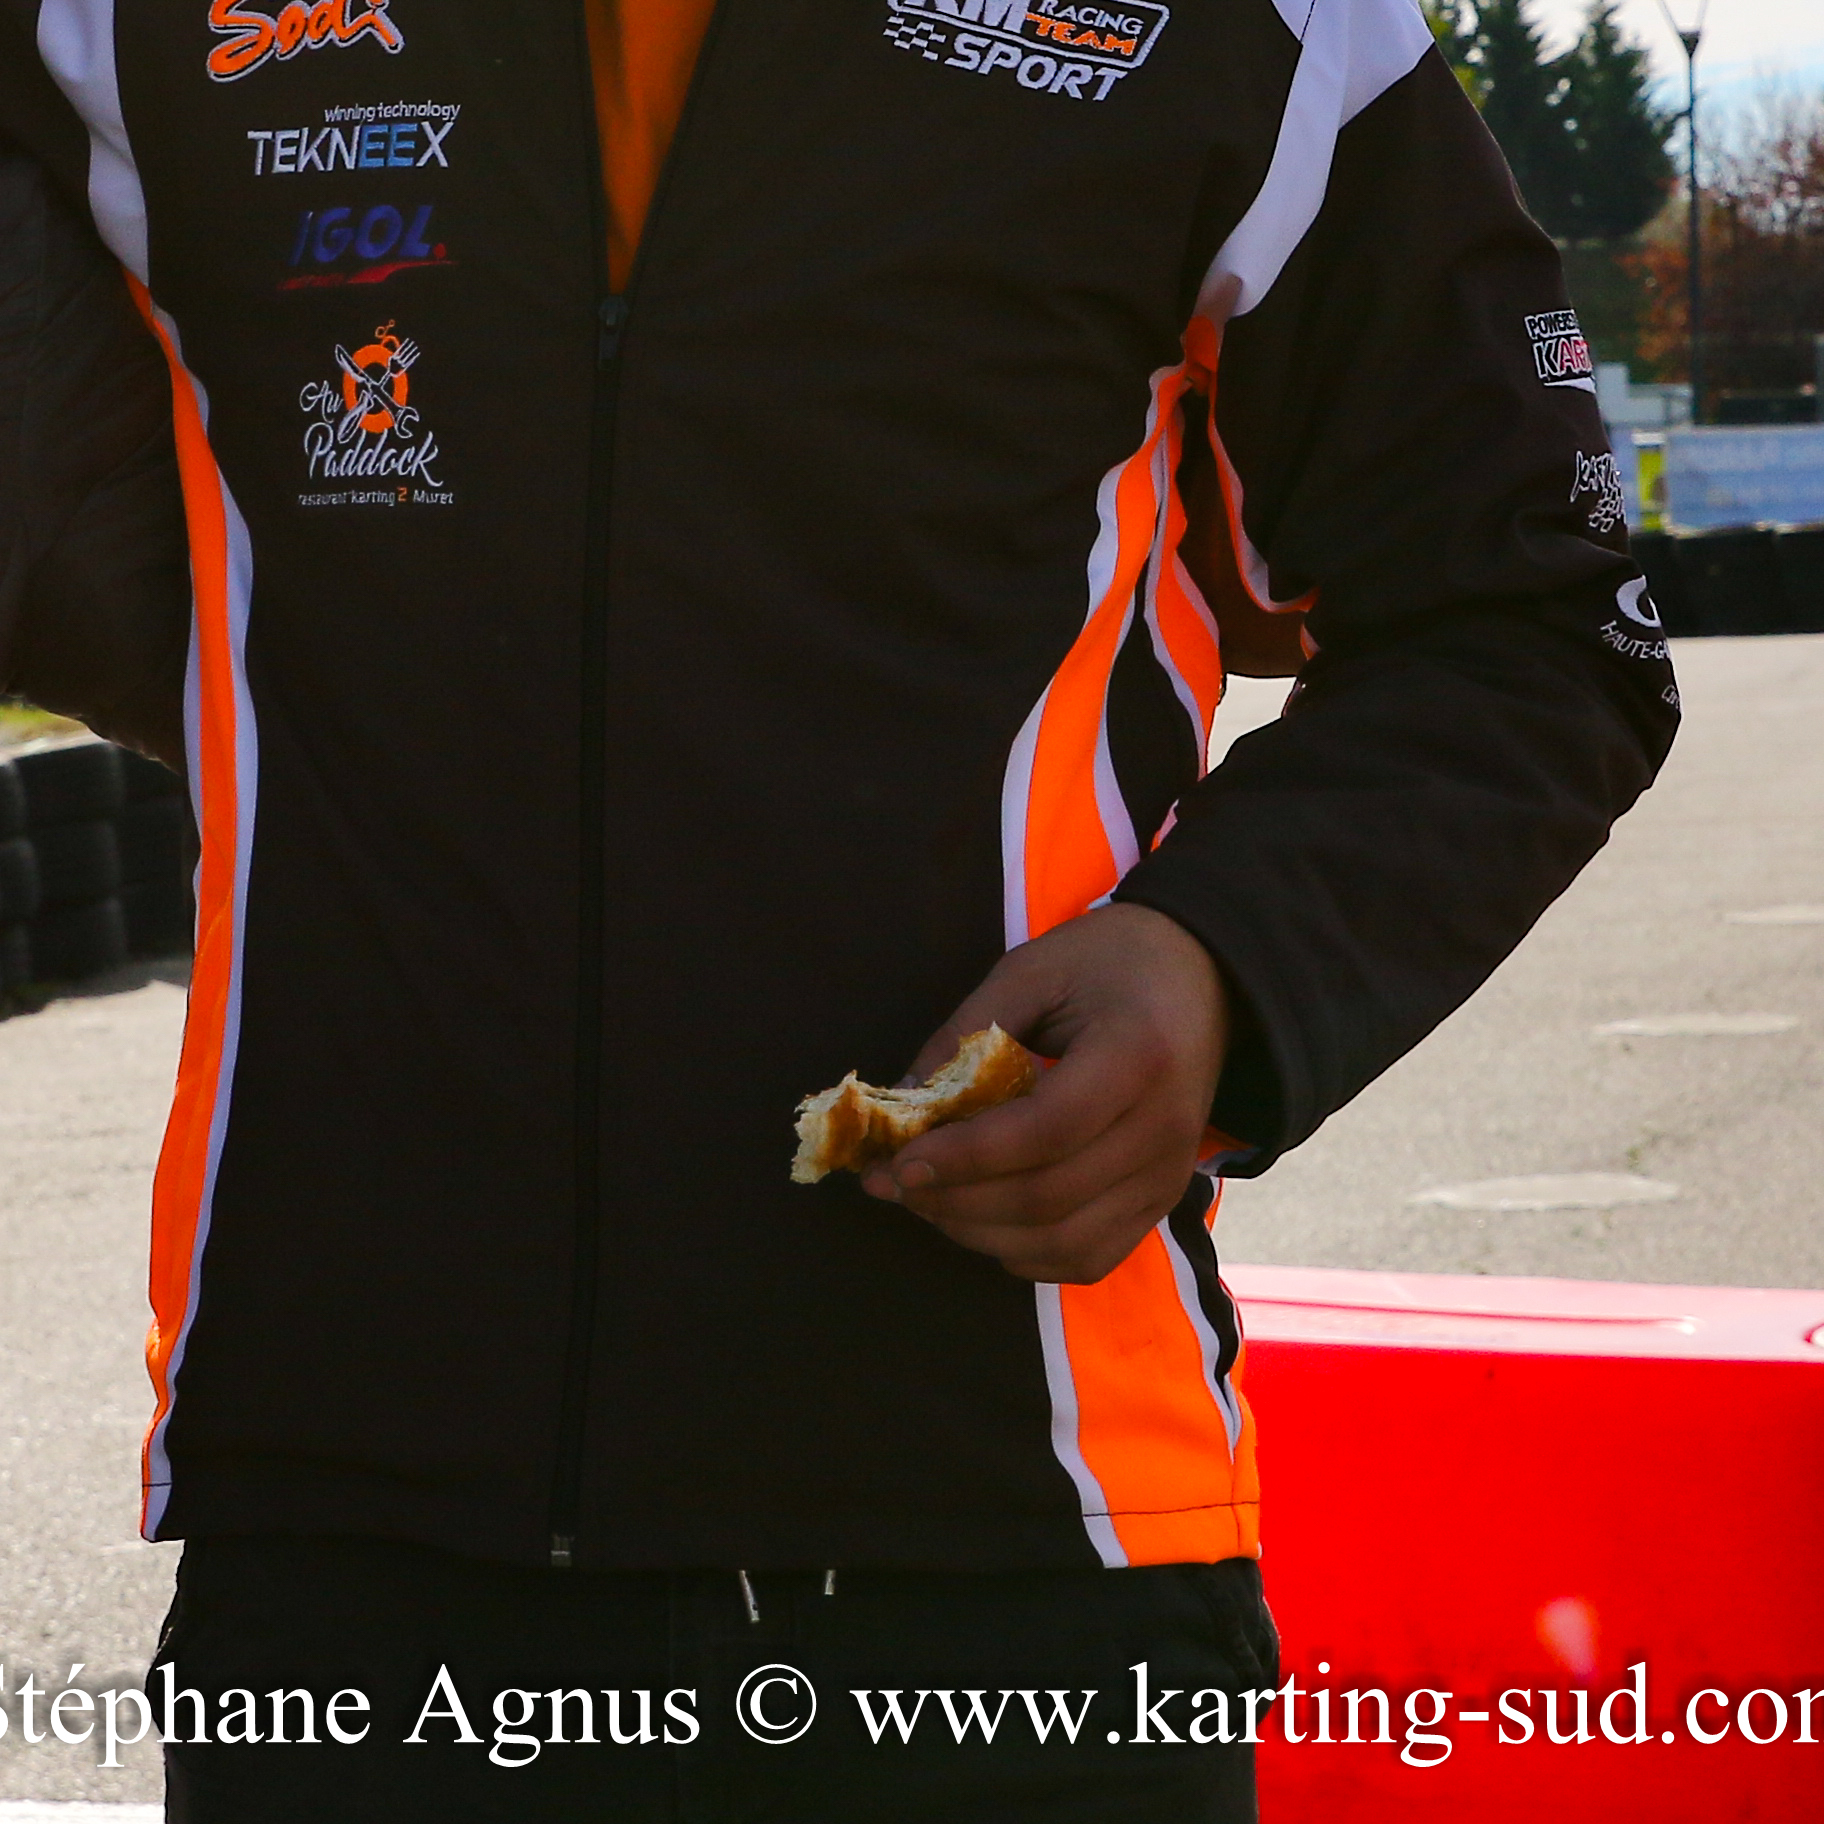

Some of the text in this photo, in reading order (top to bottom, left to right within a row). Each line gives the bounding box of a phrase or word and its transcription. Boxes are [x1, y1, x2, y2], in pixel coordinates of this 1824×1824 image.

[1026, 12, 1138, 56] TEAM
[944, 32, 1129, 101] SPORT
[325, 100, 461, 122] winning technology
[247, 121, 455, 176] TEKNEEX
[299, 380, 344, 424] Au
[304, 422, 444, 487] Paddock
[412, 489, 454, 505] Muret
